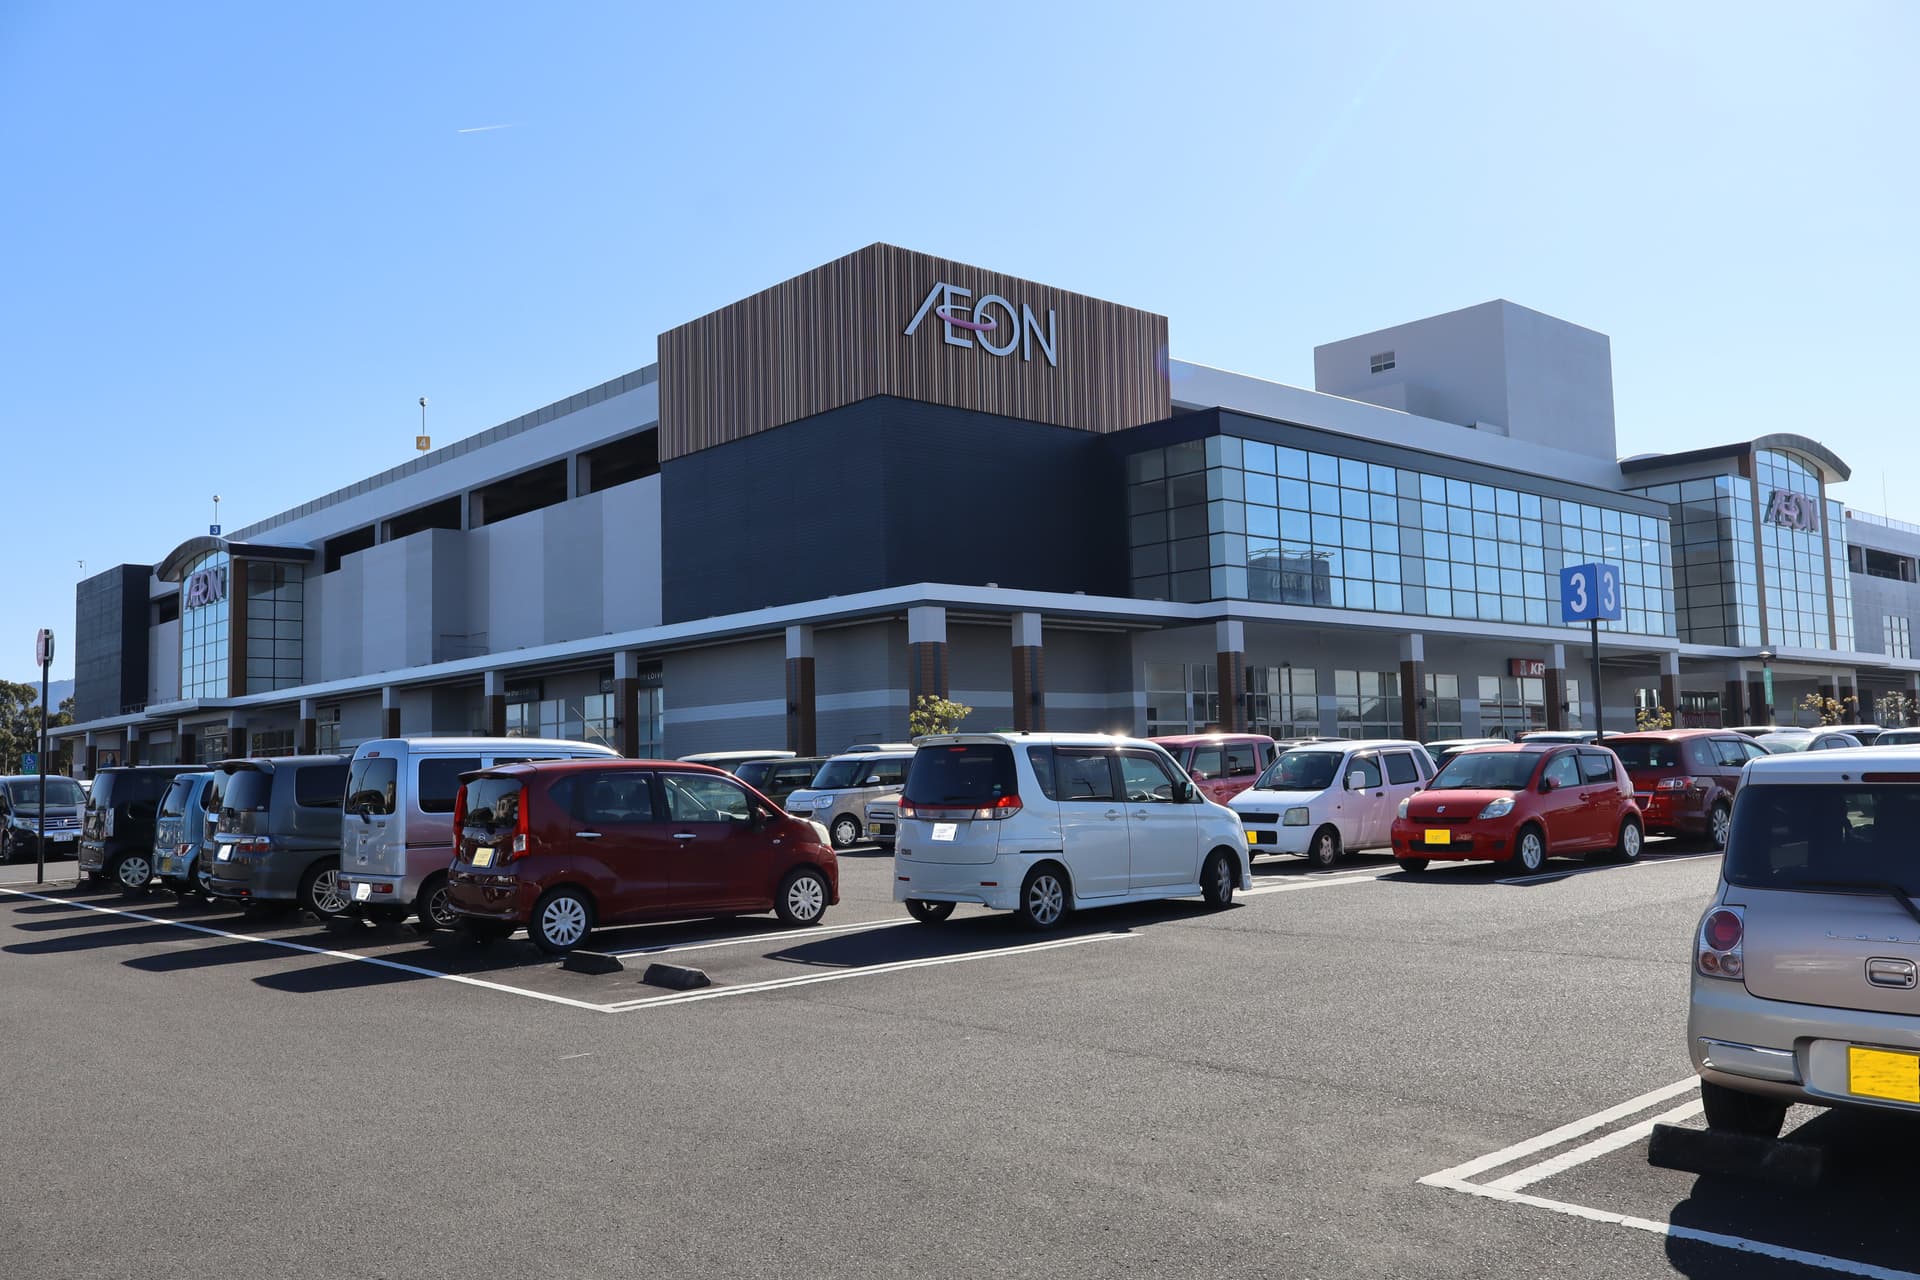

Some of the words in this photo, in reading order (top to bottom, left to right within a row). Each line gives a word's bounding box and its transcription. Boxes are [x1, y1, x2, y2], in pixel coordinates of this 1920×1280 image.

[212, 525, 218, 535] 3
[1570, 572, 1587, 613] 3
[1603, 571, 1616, 612] 3
